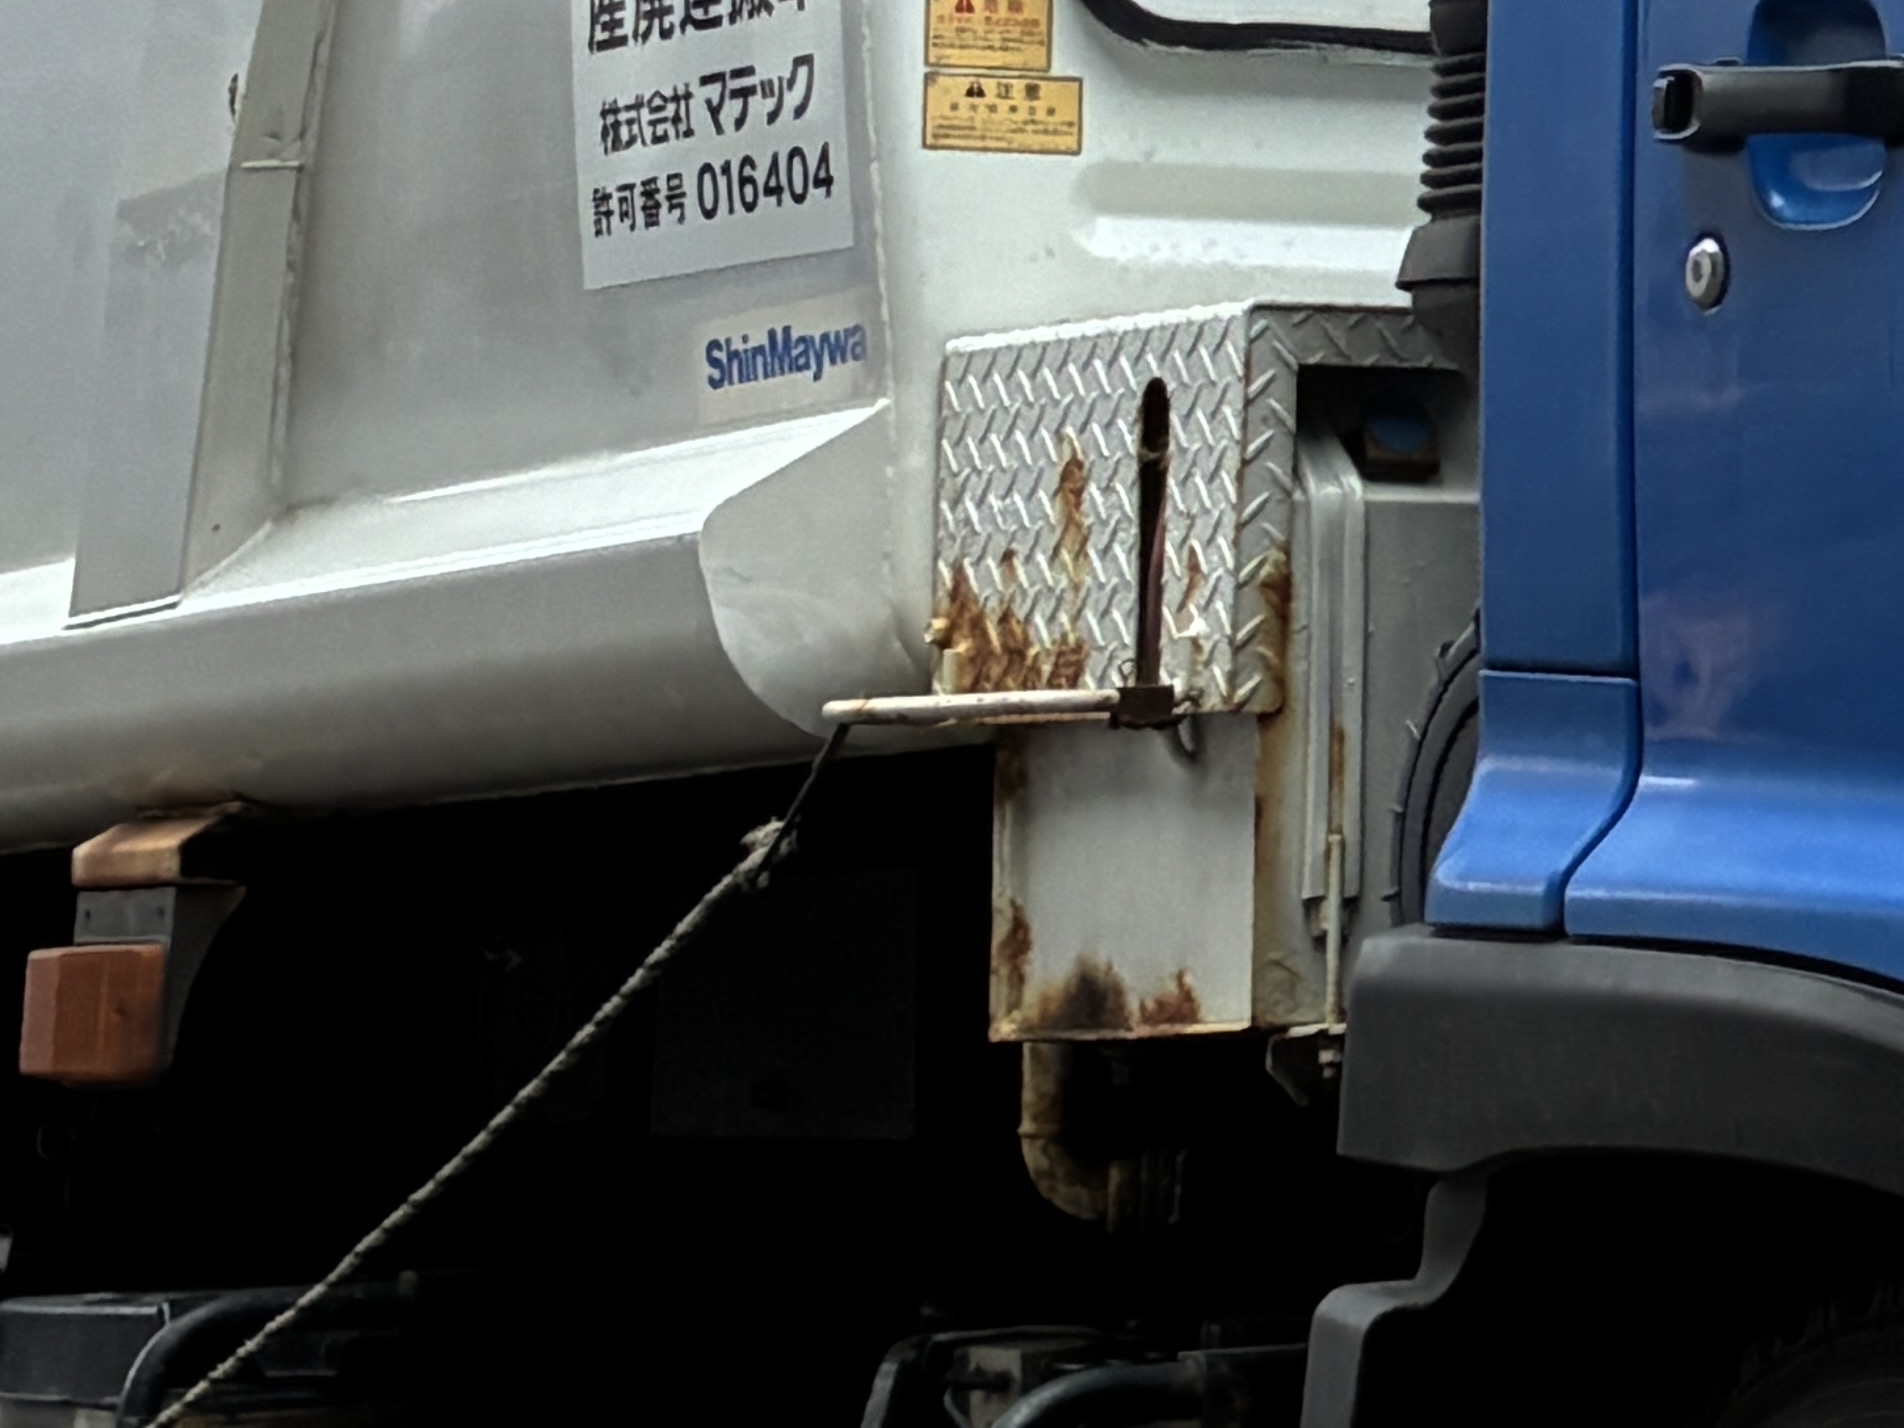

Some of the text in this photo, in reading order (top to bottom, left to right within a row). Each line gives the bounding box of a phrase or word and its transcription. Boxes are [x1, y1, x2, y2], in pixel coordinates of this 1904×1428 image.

[592, 142, 836, 238] 許可番号 016404
[706, 323, 868, 391] ShinMaywa
